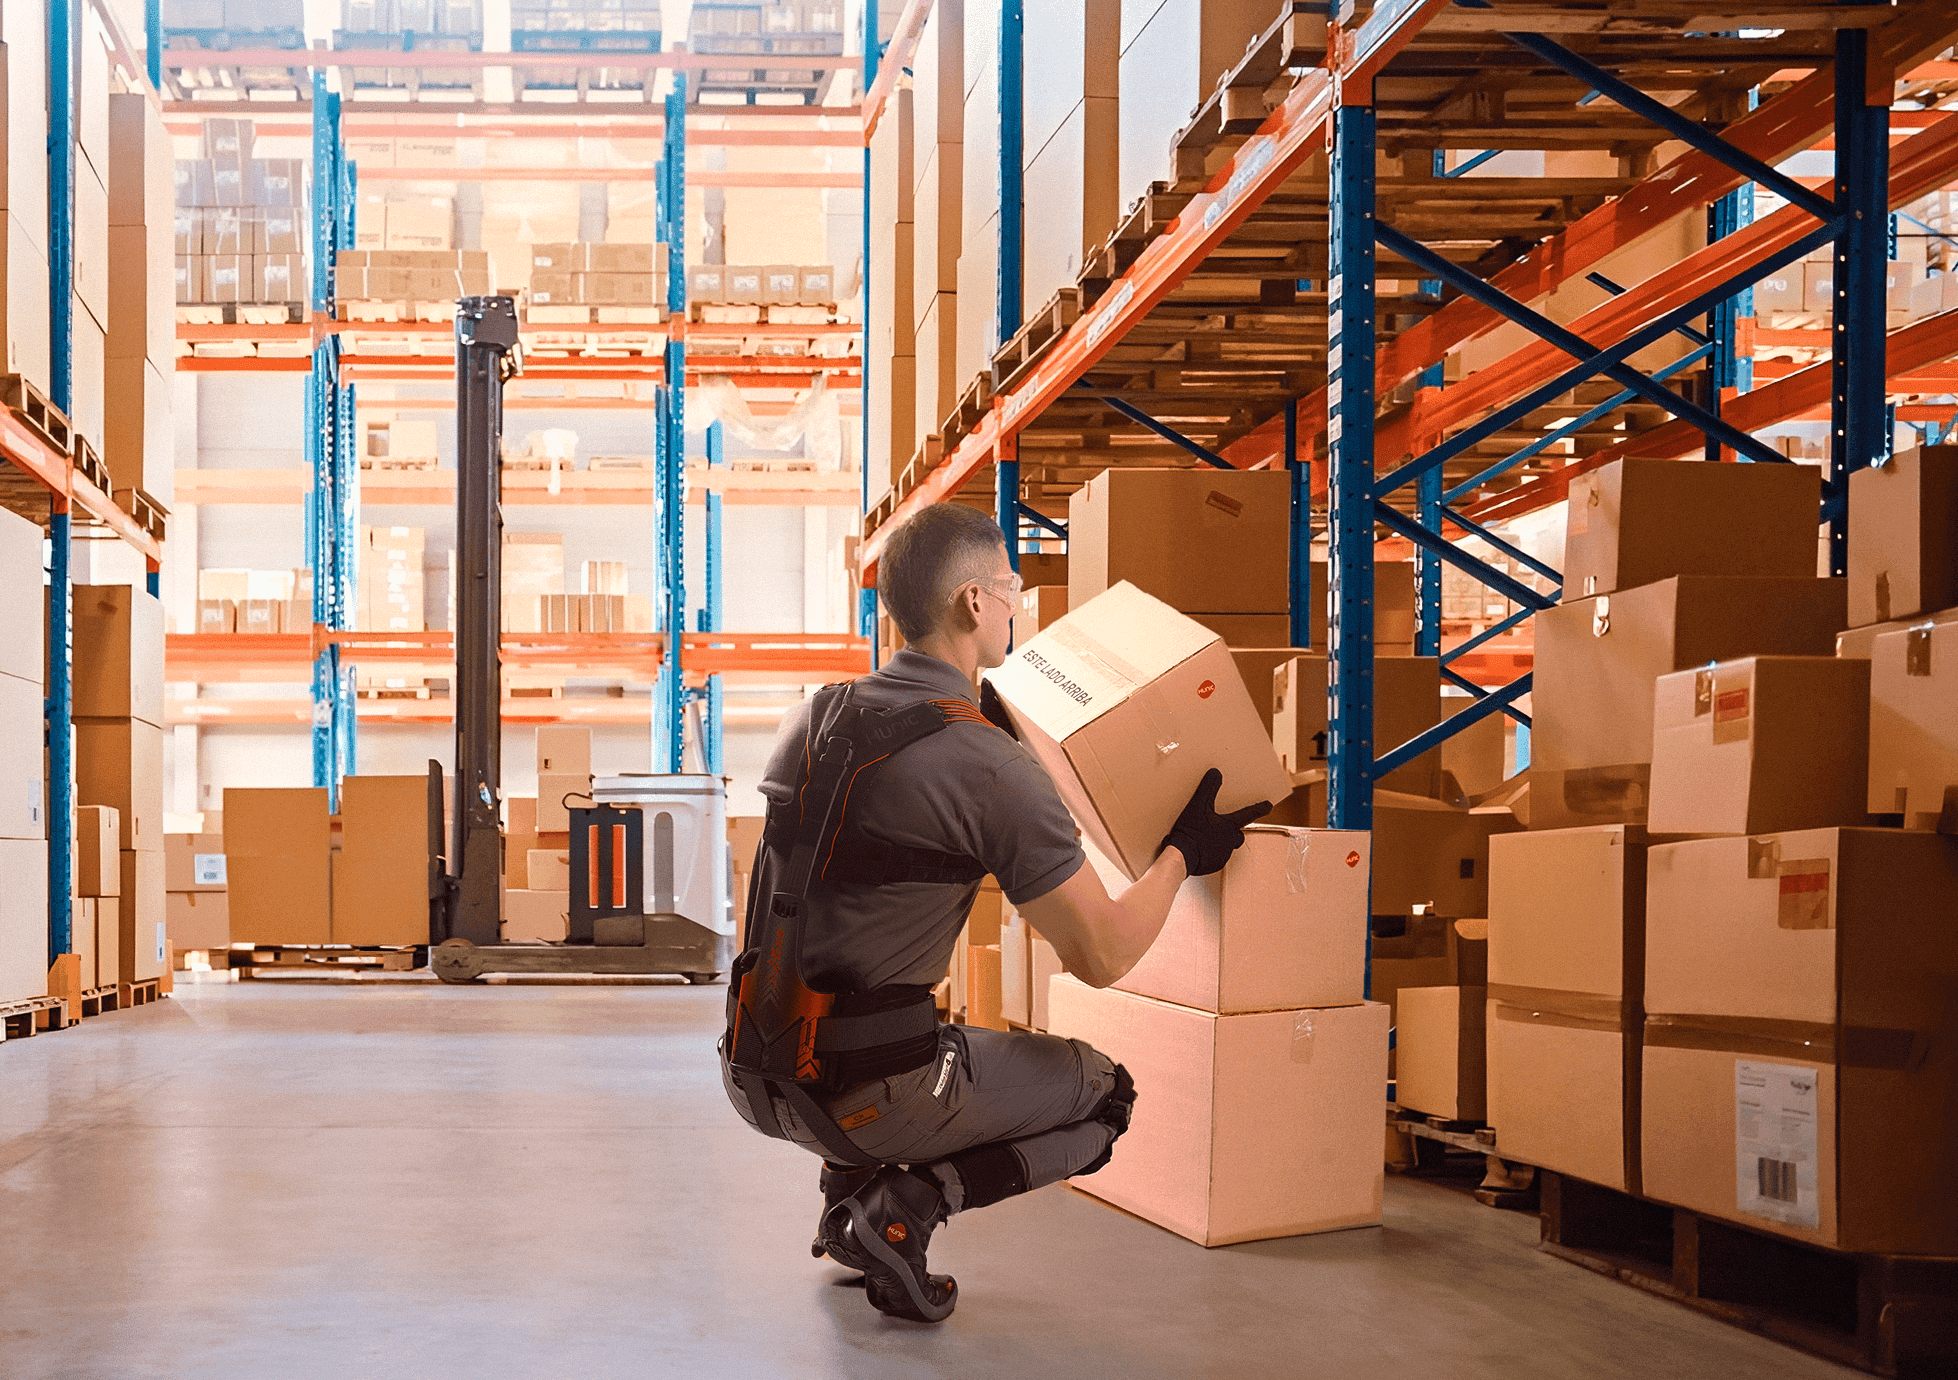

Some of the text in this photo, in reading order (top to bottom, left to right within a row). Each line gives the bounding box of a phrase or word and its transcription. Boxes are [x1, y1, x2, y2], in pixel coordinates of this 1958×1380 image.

[1022, 649, 1093, 707] ESTE LADO ARRIBA
